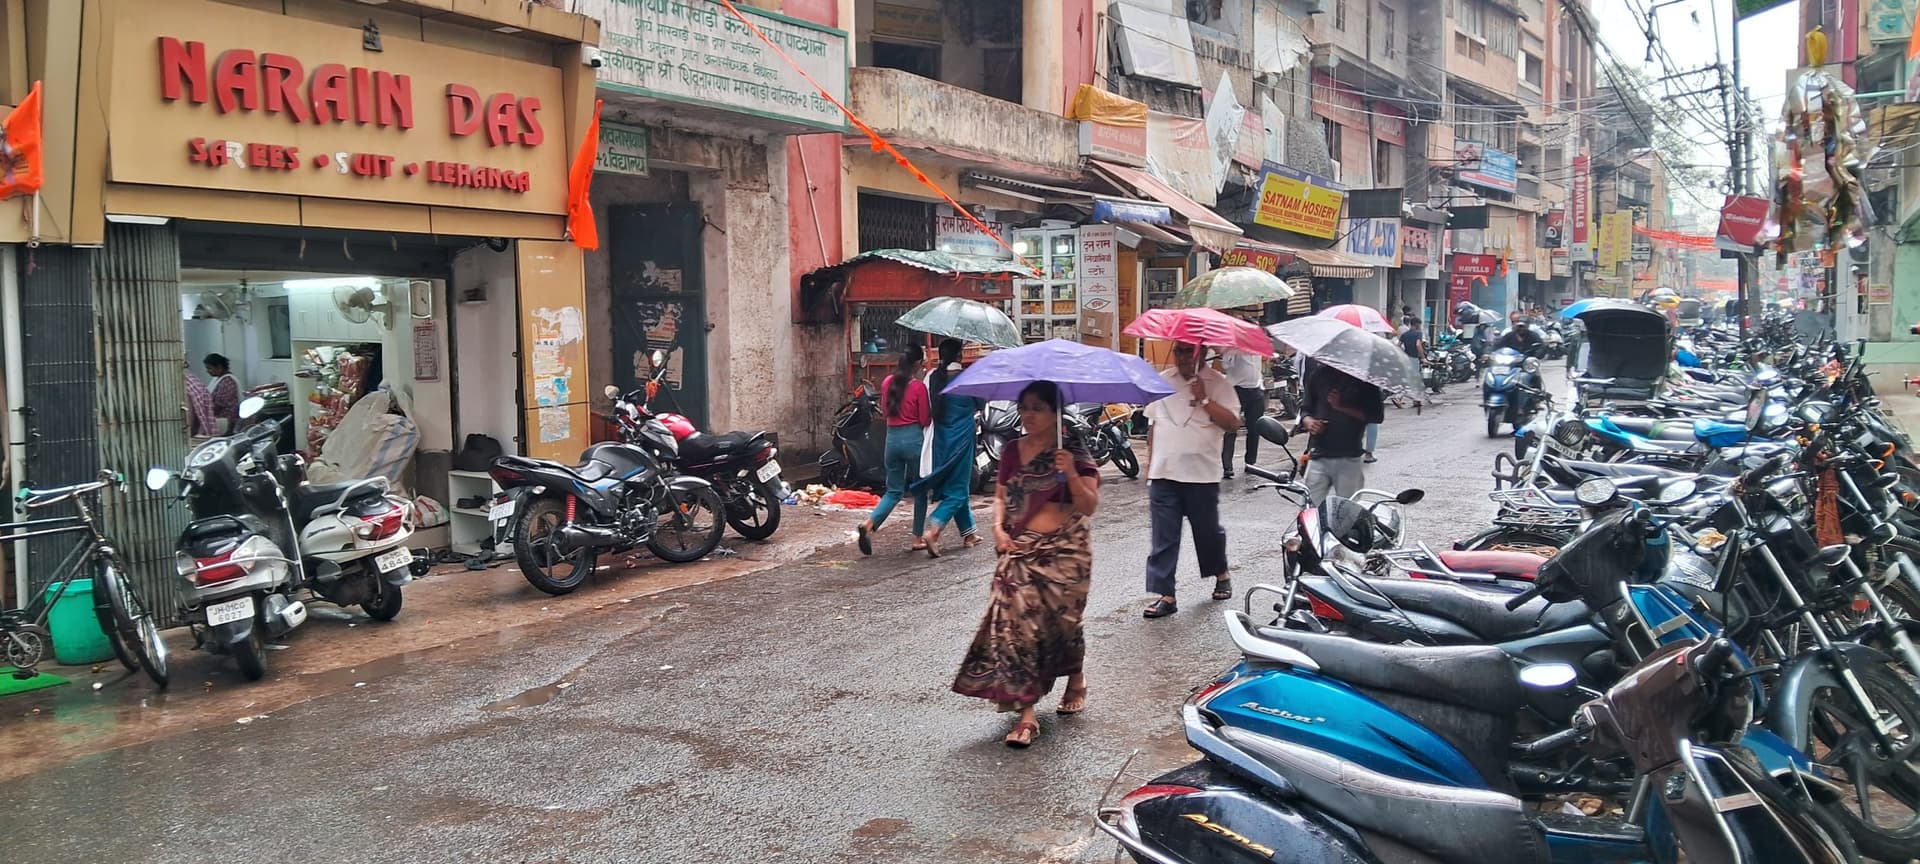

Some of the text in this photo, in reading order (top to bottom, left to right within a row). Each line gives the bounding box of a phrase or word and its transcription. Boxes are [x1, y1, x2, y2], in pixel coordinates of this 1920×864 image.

[657, 59, 674, 81] श्री
[158, 36, 545, 148] NARAIN DAS
[189, 136, 531, 194] SAREES SUIT LEHANGA
[1263, 190, 1302, 212] SATNAM
[1301, 200, 1339, 220] HOSIERY
[1575, 184, 1585, 229] HAVELLS
[1222, 250, 1277, 274] Sale 50%
[1458, 265, 1490, 274] HAVELLS
[1237, 701, 1313, 725] Activa
